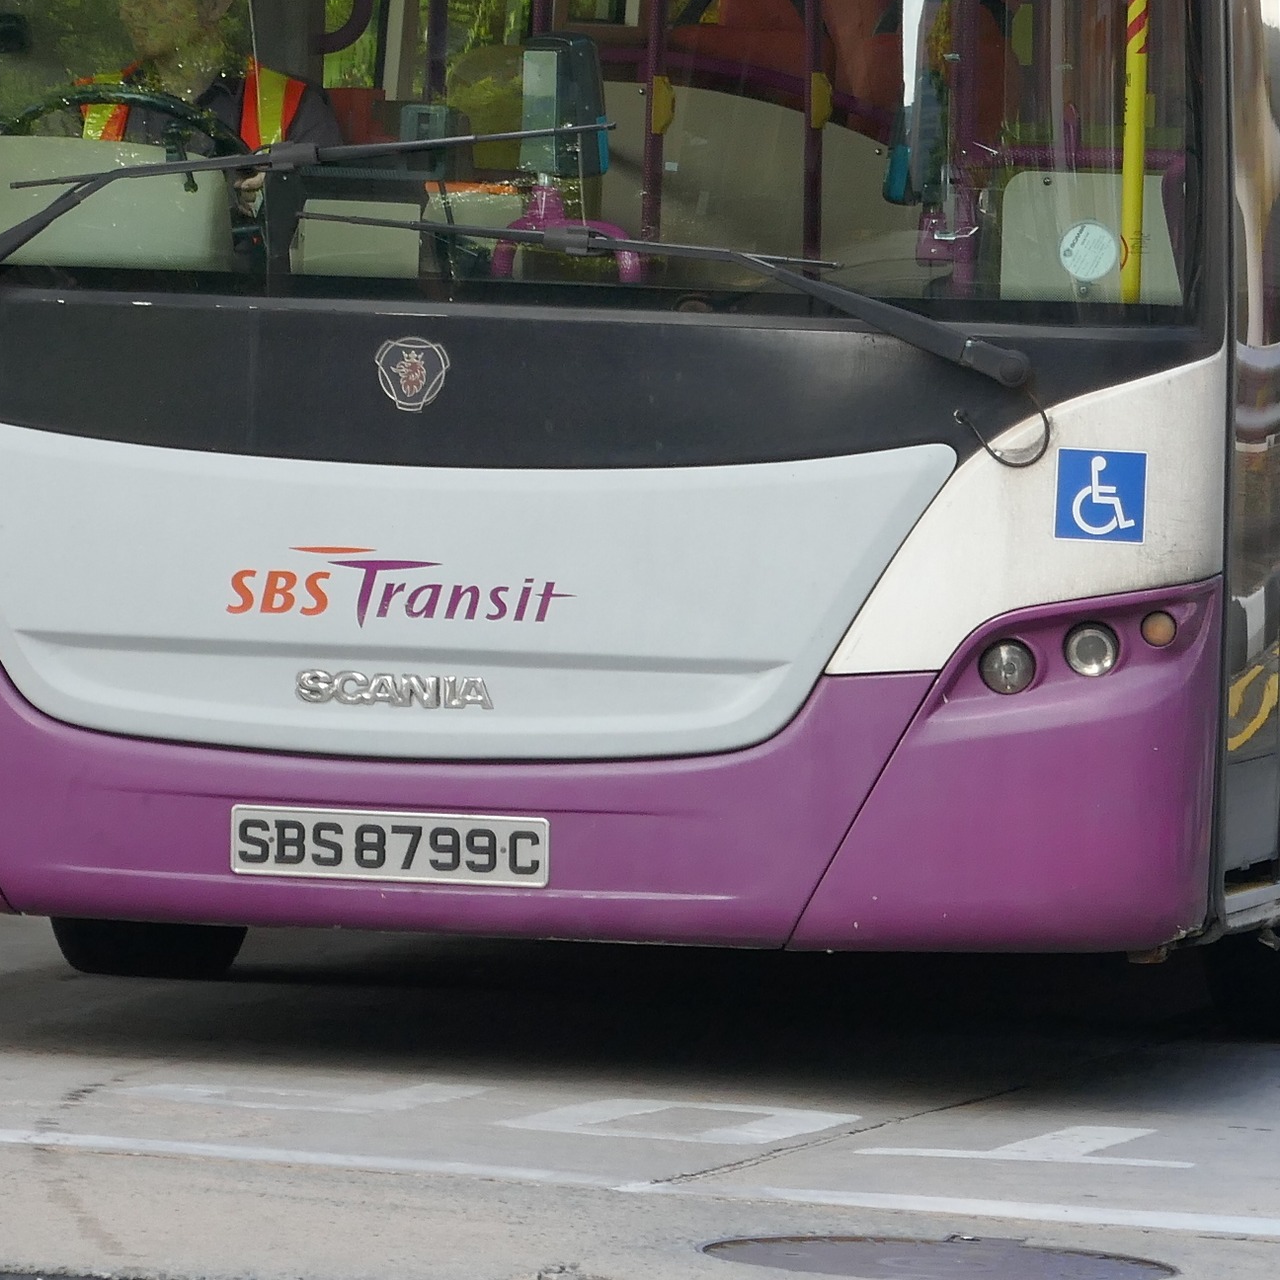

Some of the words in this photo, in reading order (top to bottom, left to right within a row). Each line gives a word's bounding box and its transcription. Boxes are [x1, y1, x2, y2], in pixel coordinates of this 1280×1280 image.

[225, 568, 331, 616] SBS
[327, 559, 578, 628] Transit
[295, 669, 494, 711] SCANIA
[237, 818, 541, 876] SBS8799C
